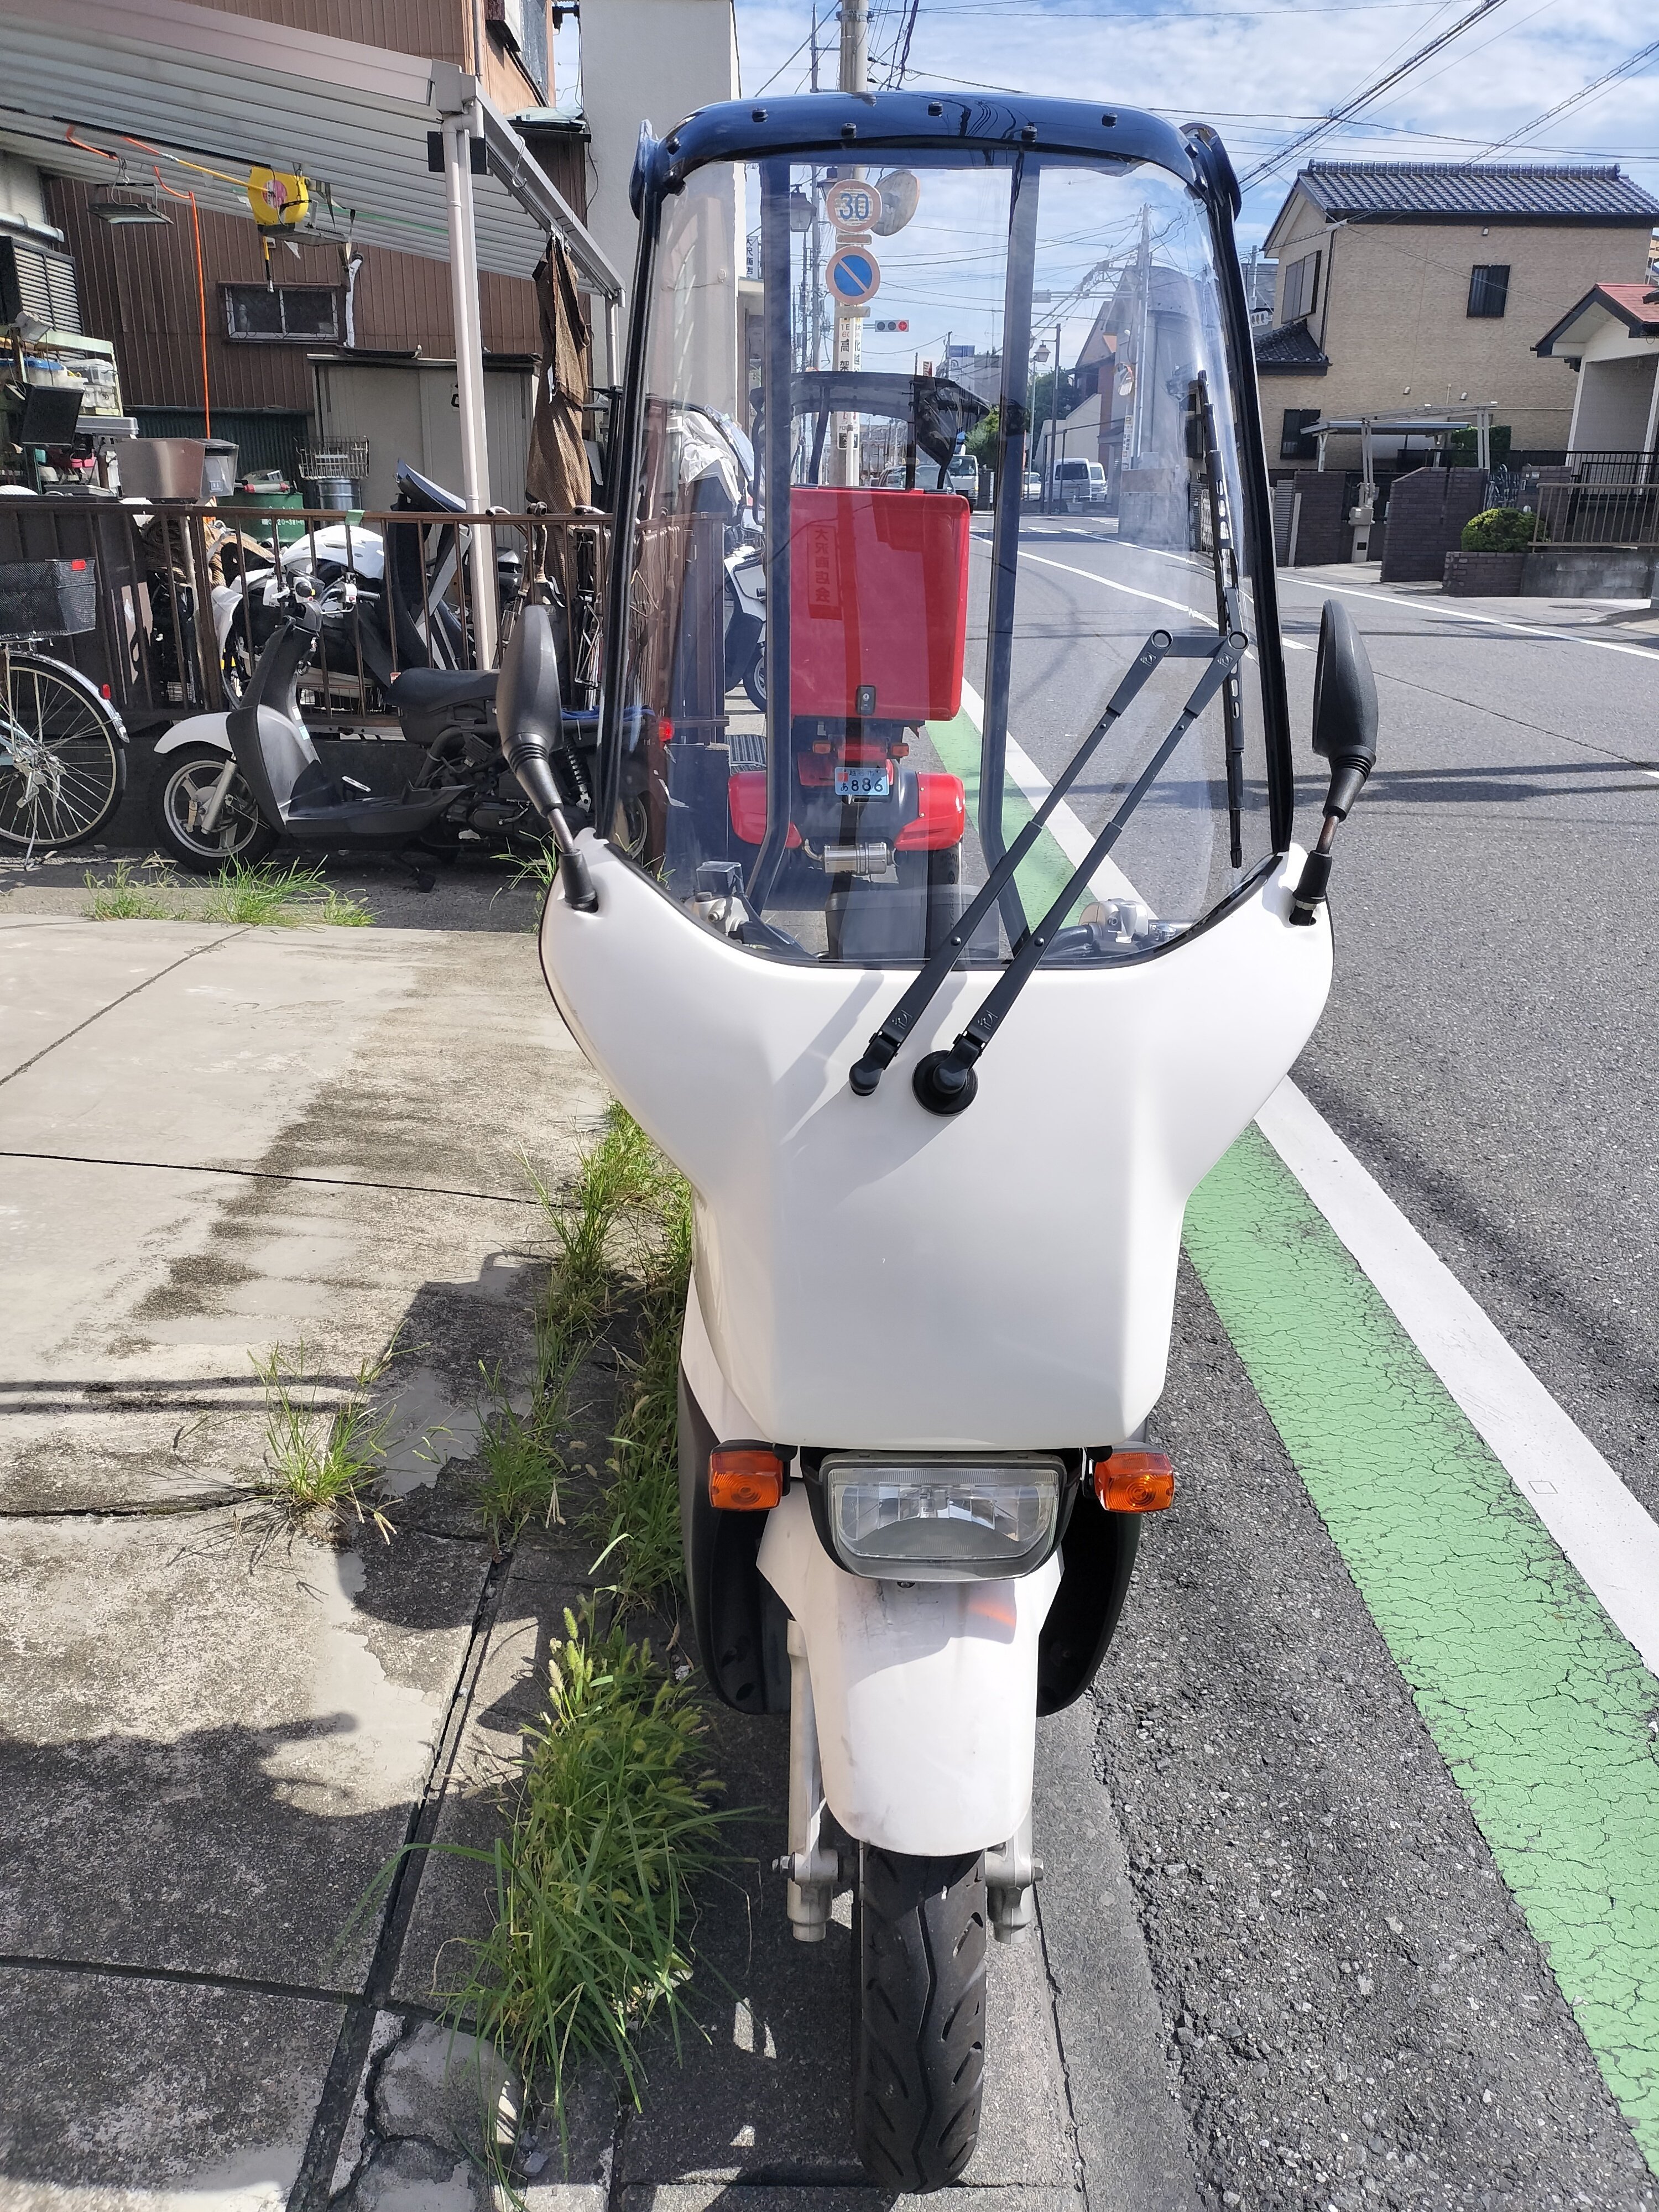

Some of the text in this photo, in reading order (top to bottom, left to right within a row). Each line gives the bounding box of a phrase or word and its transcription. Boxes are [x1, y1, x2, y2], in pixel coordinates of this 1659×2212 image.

[840, 193, 869, 220] 30
[841, 778, 883, 792] あ 886
